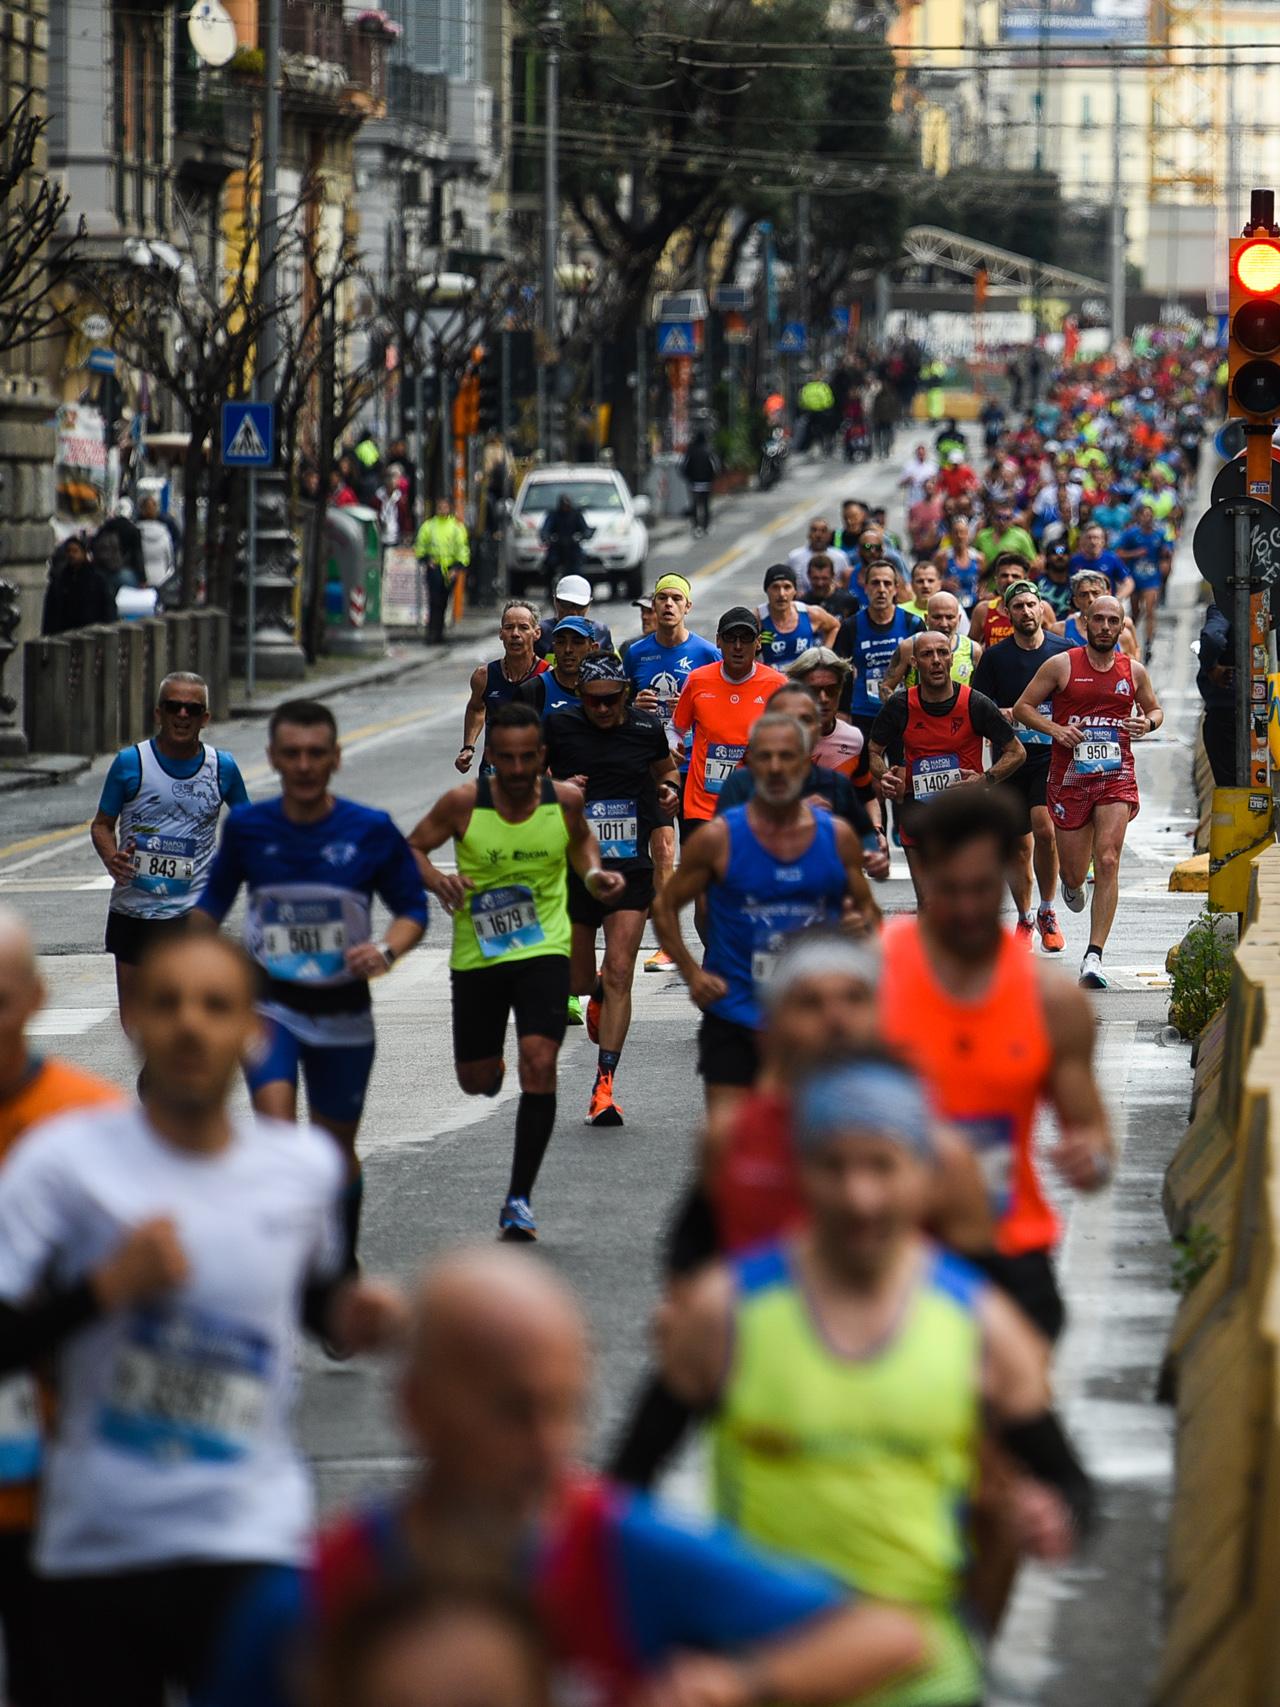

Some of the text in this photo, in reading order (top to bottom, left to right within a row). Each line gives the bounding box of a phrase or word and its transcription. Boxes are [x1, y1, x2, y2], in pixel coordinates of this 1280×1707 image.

[1087, 745, 1107, 760] 950
[719, 763, 737, 780] 77
[923, 774, 950, 793] 1402
[607, 803, 629, 811] NAPOLI
[597, 822, 625, 841] 1011
[148, 857, 177, 879] 843
[489, 908, 524, 936] 1679
